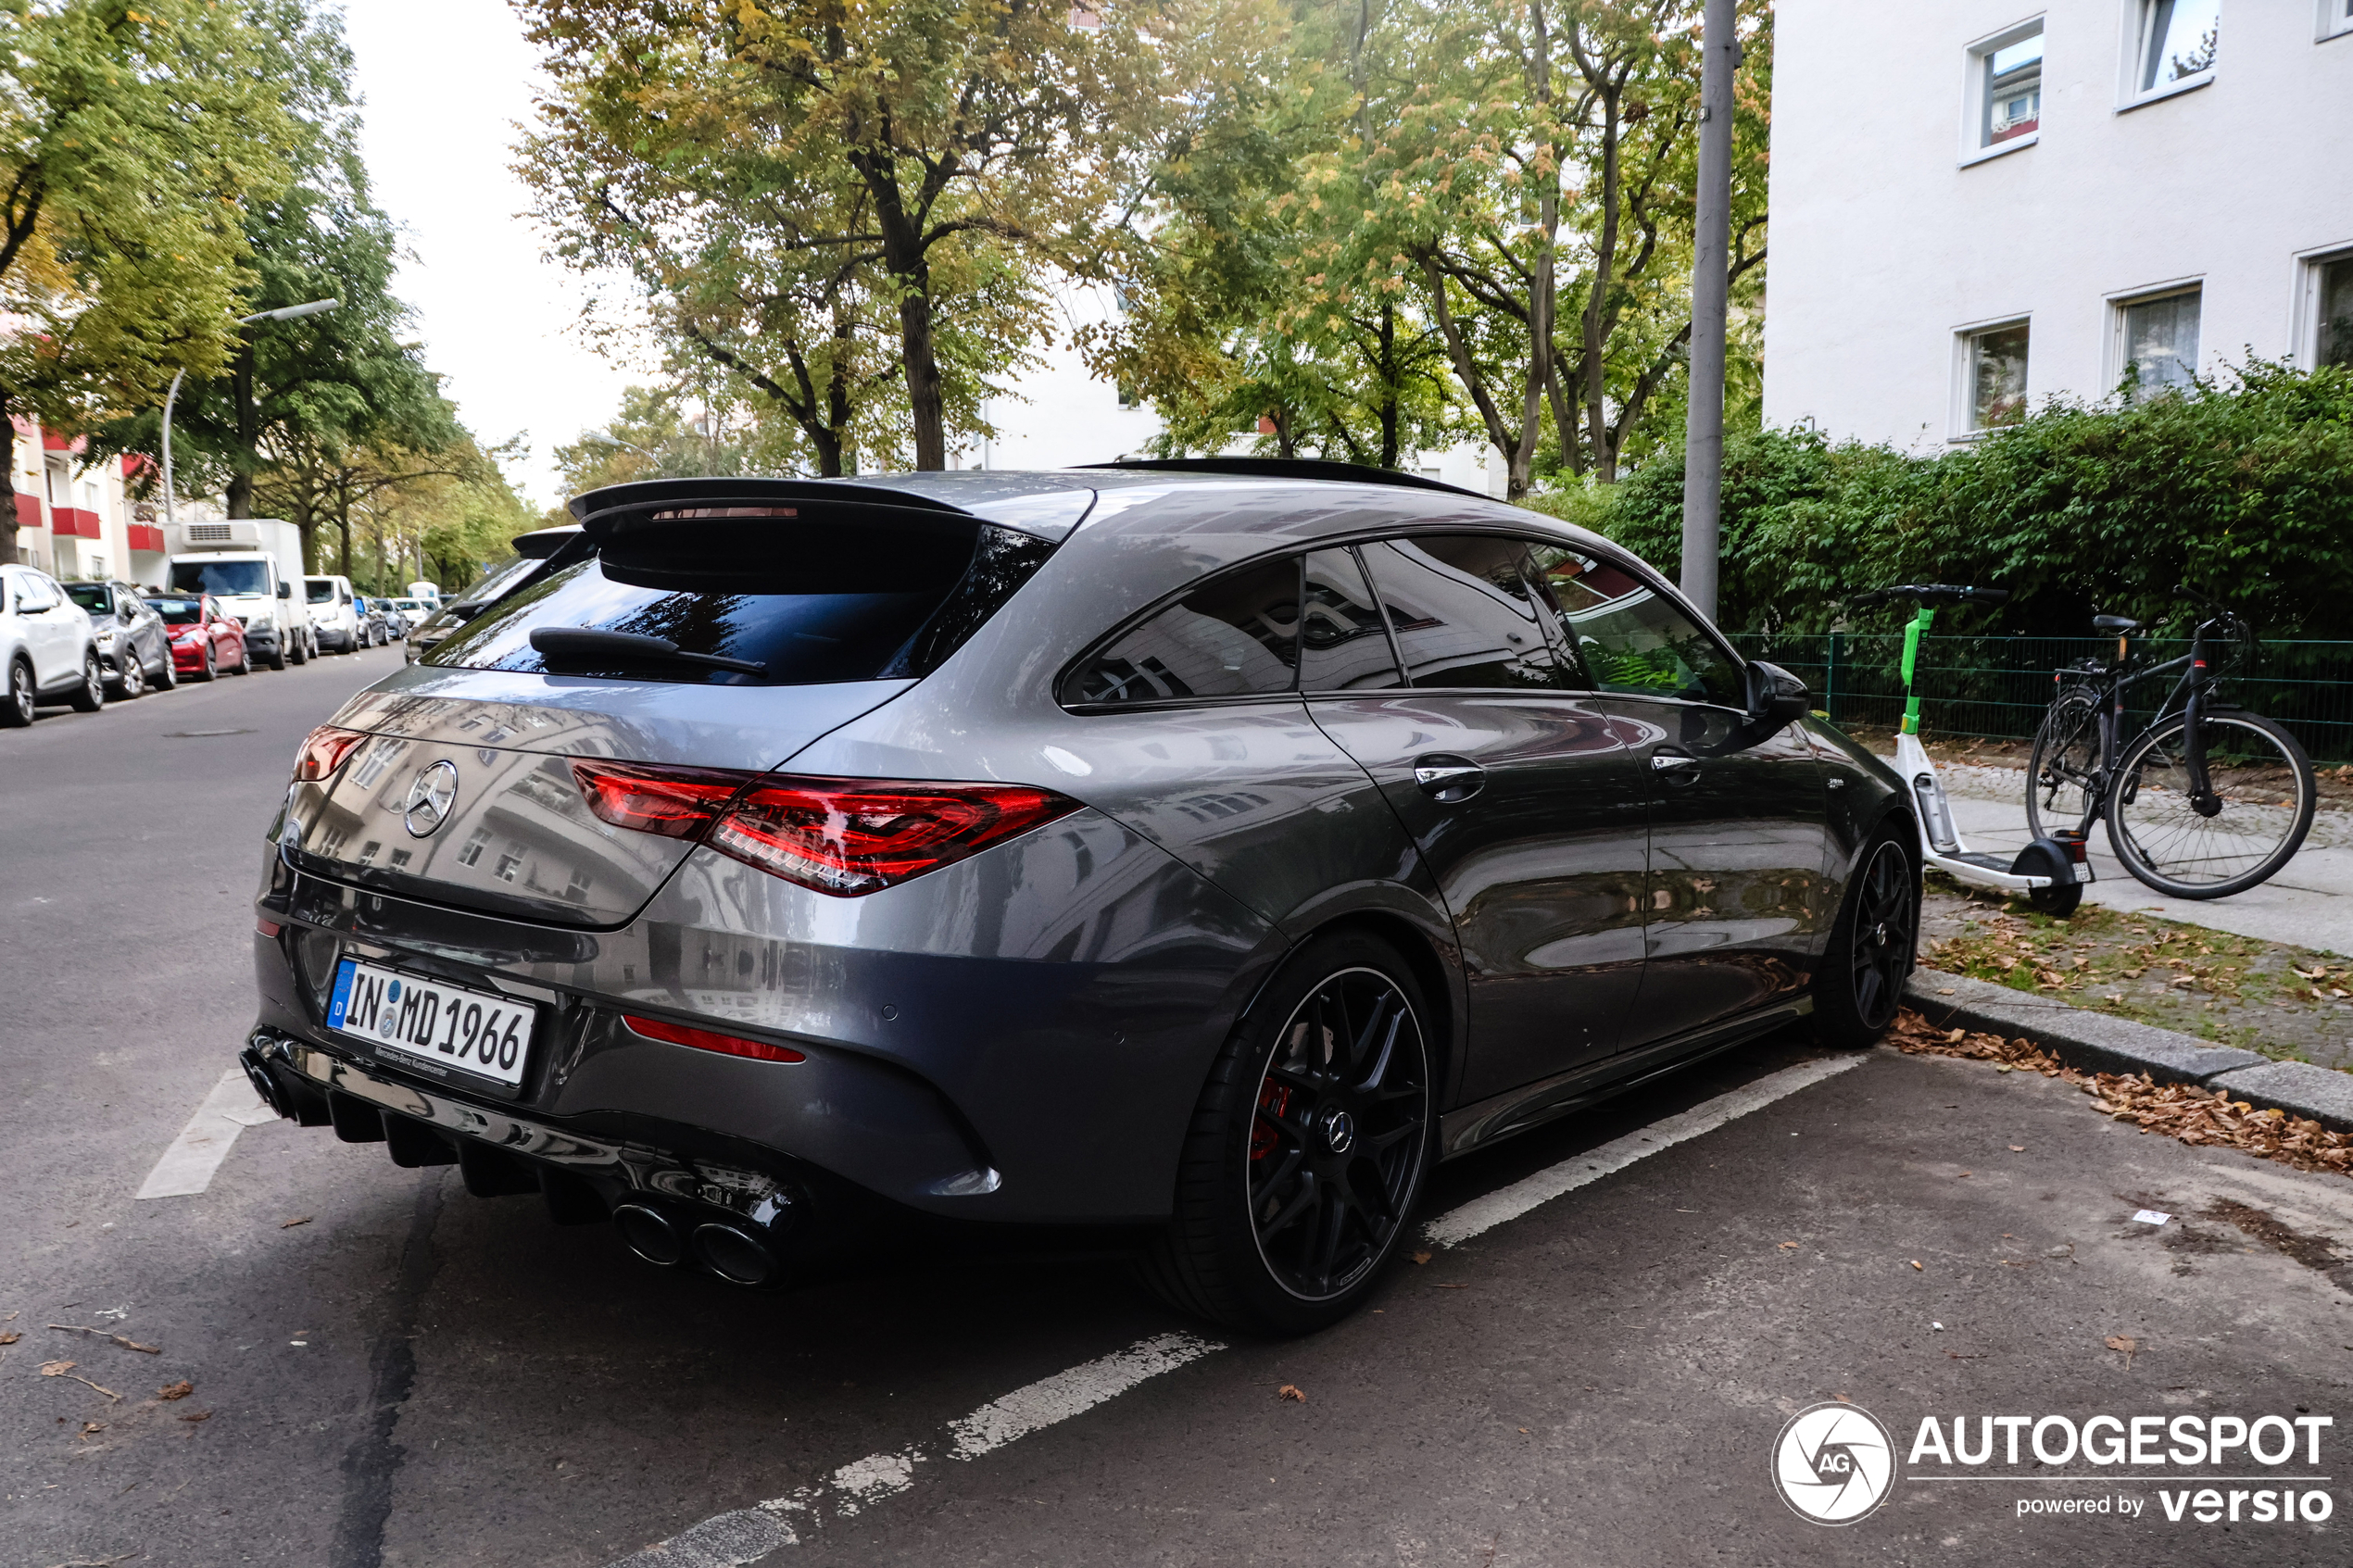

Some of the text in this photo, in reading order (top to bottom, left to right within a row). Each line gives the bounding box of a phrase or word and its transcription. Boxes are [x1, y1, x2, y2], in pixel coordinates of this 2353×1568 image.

[334, 972, 522, 1071] D IN MD 1966
[374, 1046, 447, 1077] Mercedes-Benz Kundencenter
